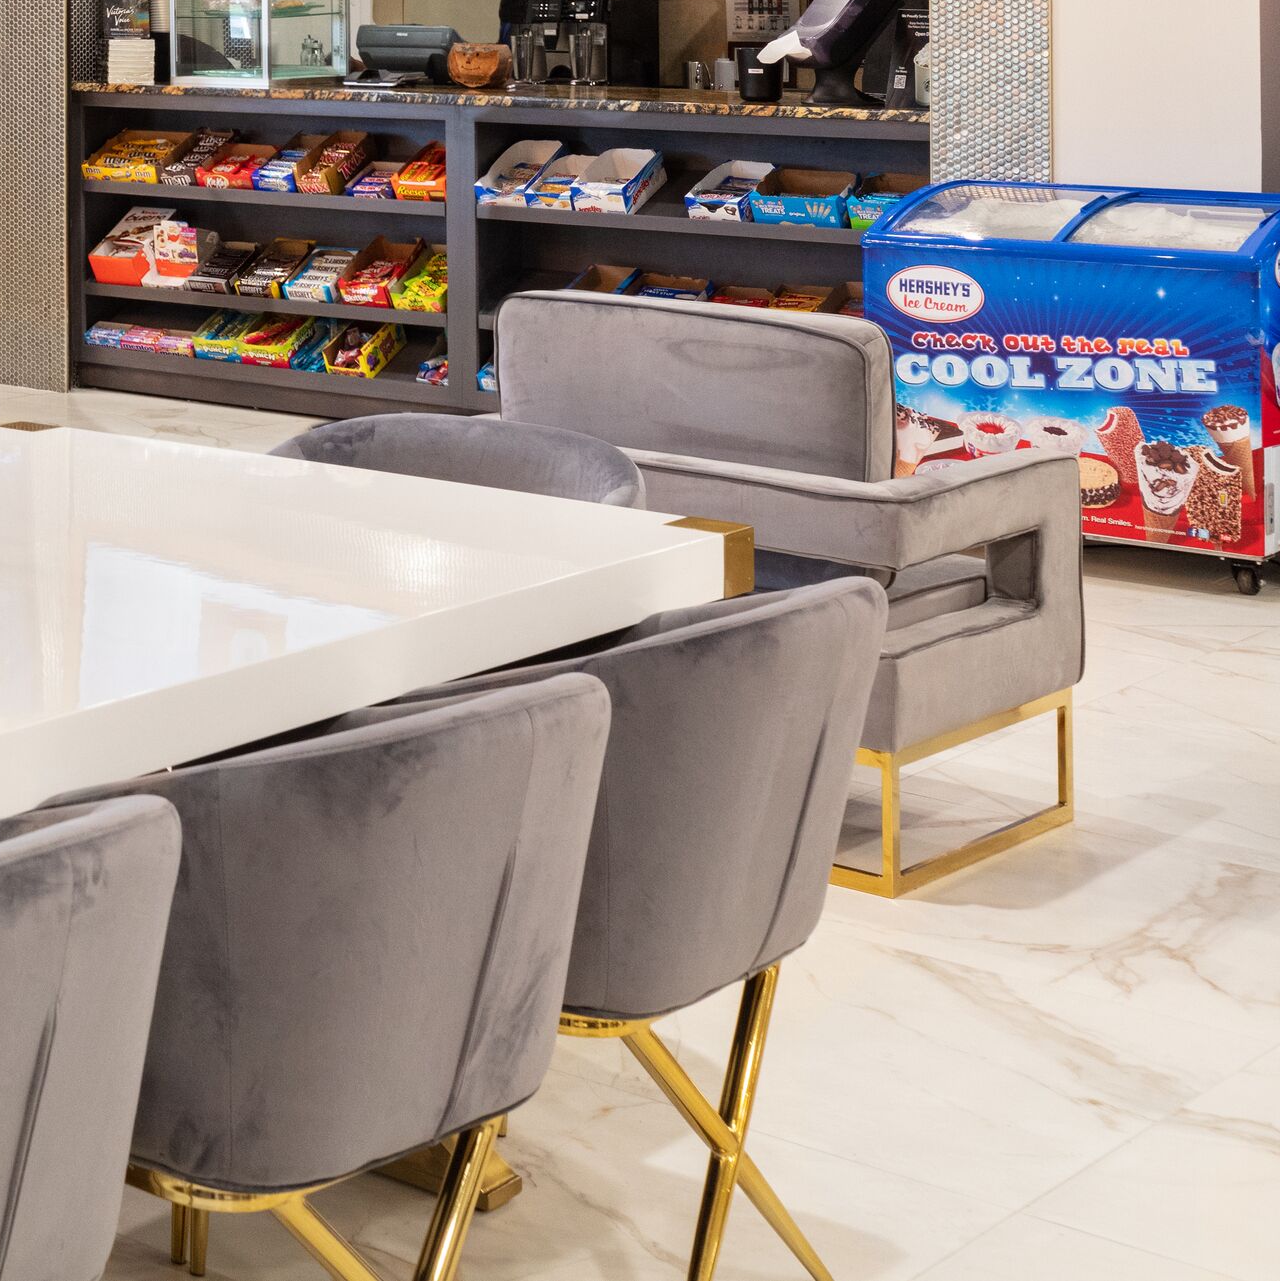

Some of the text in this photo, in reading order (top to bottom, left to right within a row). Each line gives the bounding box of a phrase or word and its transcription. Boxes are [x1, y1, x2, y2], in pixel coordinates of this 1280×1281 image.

[107, 5, 134, 18] Victoria's
[115, 13, 130, 26] Voice
[761, 207, 786, 215] TREATS
[899, 277, 971, 298] HERSHEY'S
[904, 294, 968, 313] Ice Cream
[122, 344, 154, 352] mentos
[1004, 335, 1056, 352] out
[1062, 336, 1111, 354] the
[1118, 338, 1189, 356] real
[896, 353, 1217, 393] COOL ZONE
[1091, 516, 1106, 524] Real
[1108, 518, 1133, 527] Smiles.
